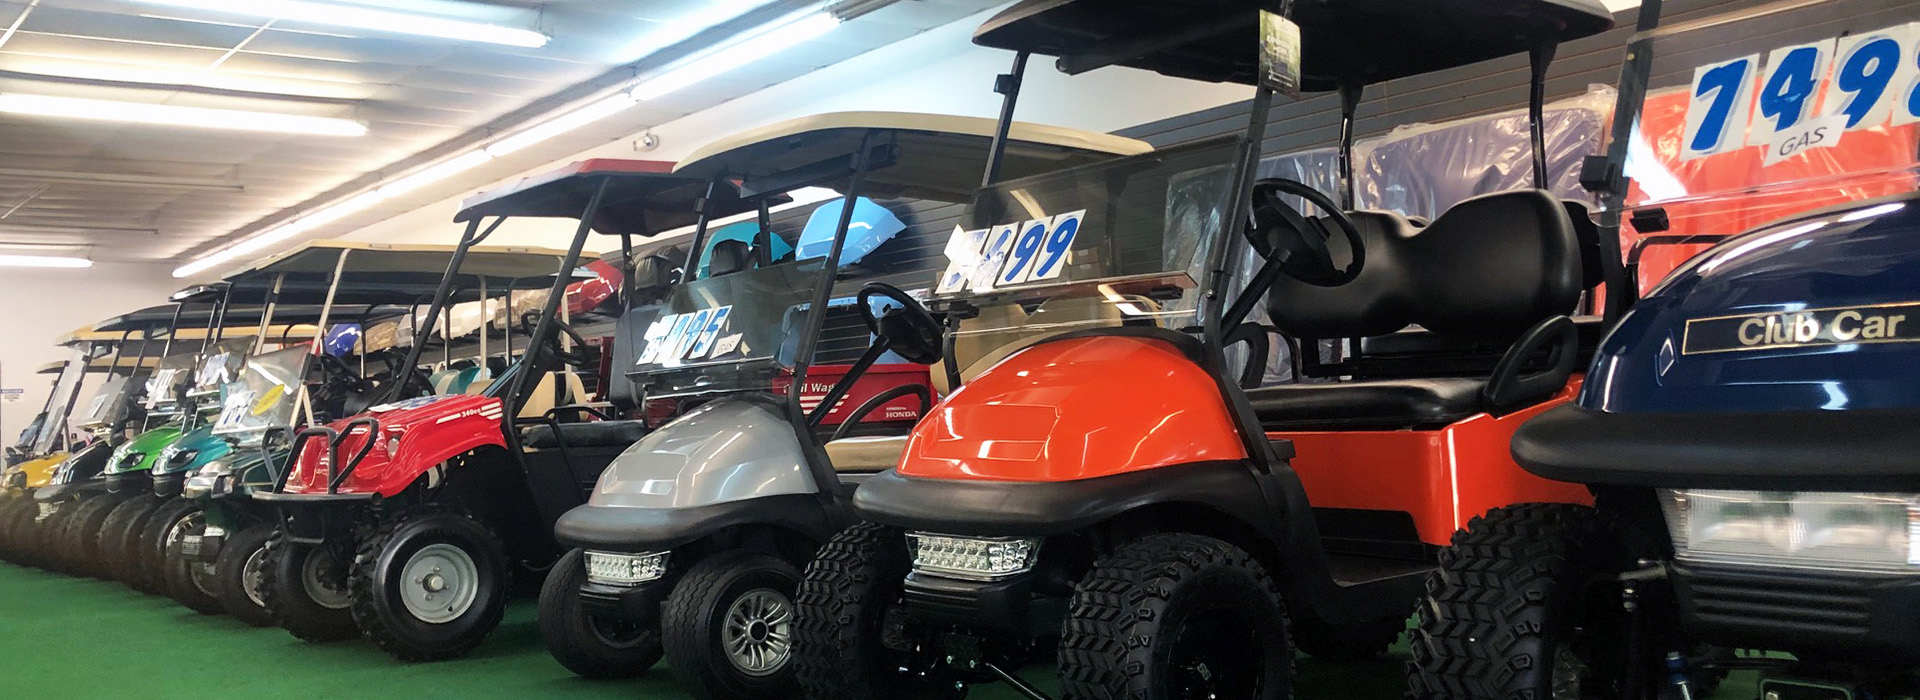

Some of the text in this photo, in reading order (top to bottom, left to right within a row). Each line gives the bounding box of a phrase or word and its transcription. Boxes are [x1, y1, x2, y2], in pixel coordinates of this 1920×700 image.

[1690, 38, 1920, 151] 749
[1779, 126, 1828, 156] GAS
[1738, 311, 1905, 345] Club Car
[811, 382, 836, 394] Wag
